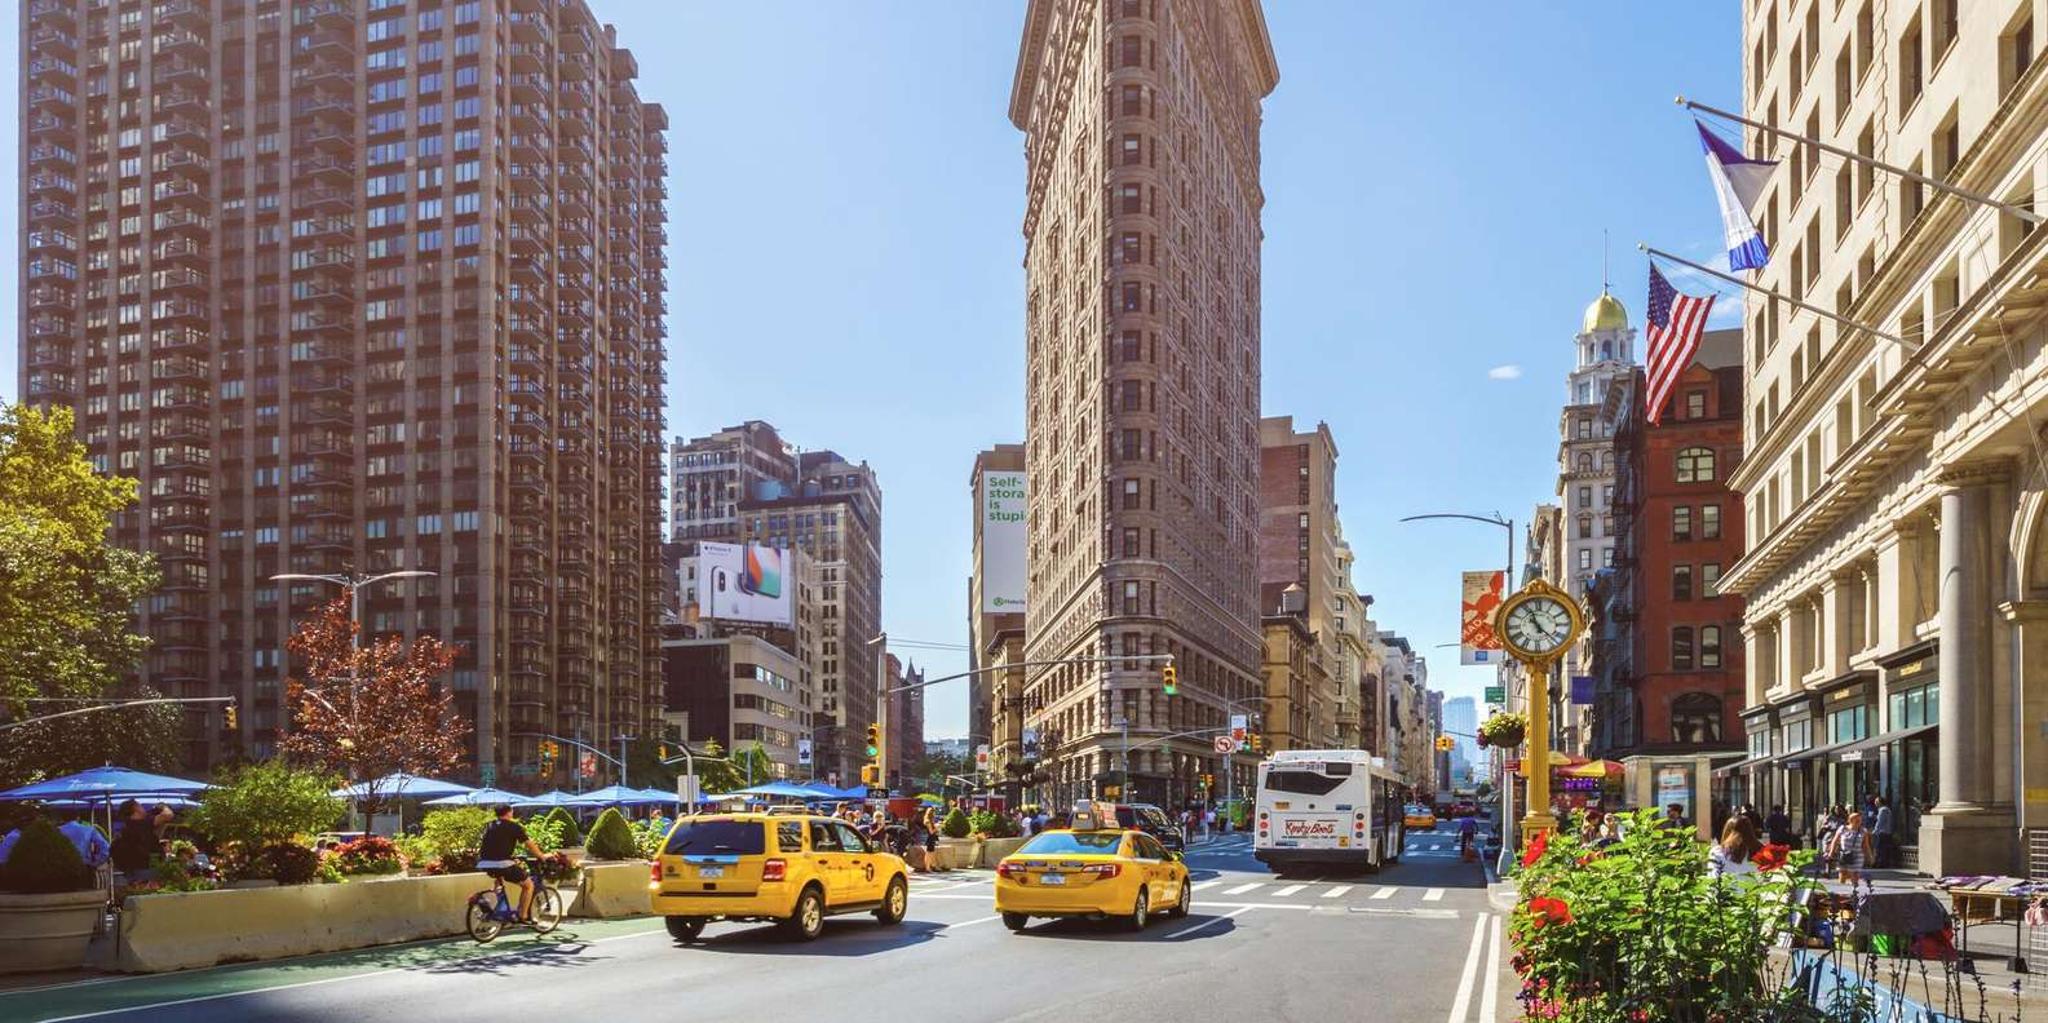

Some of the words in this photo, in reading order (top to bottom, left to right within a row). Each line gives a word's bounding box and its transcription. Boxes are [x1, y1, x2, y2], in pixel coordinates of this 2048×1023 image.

[990, 476, 1022, 487] Self-
[990, 500, 1000, 510] is
[989, 510, 1026, 522] stupi
